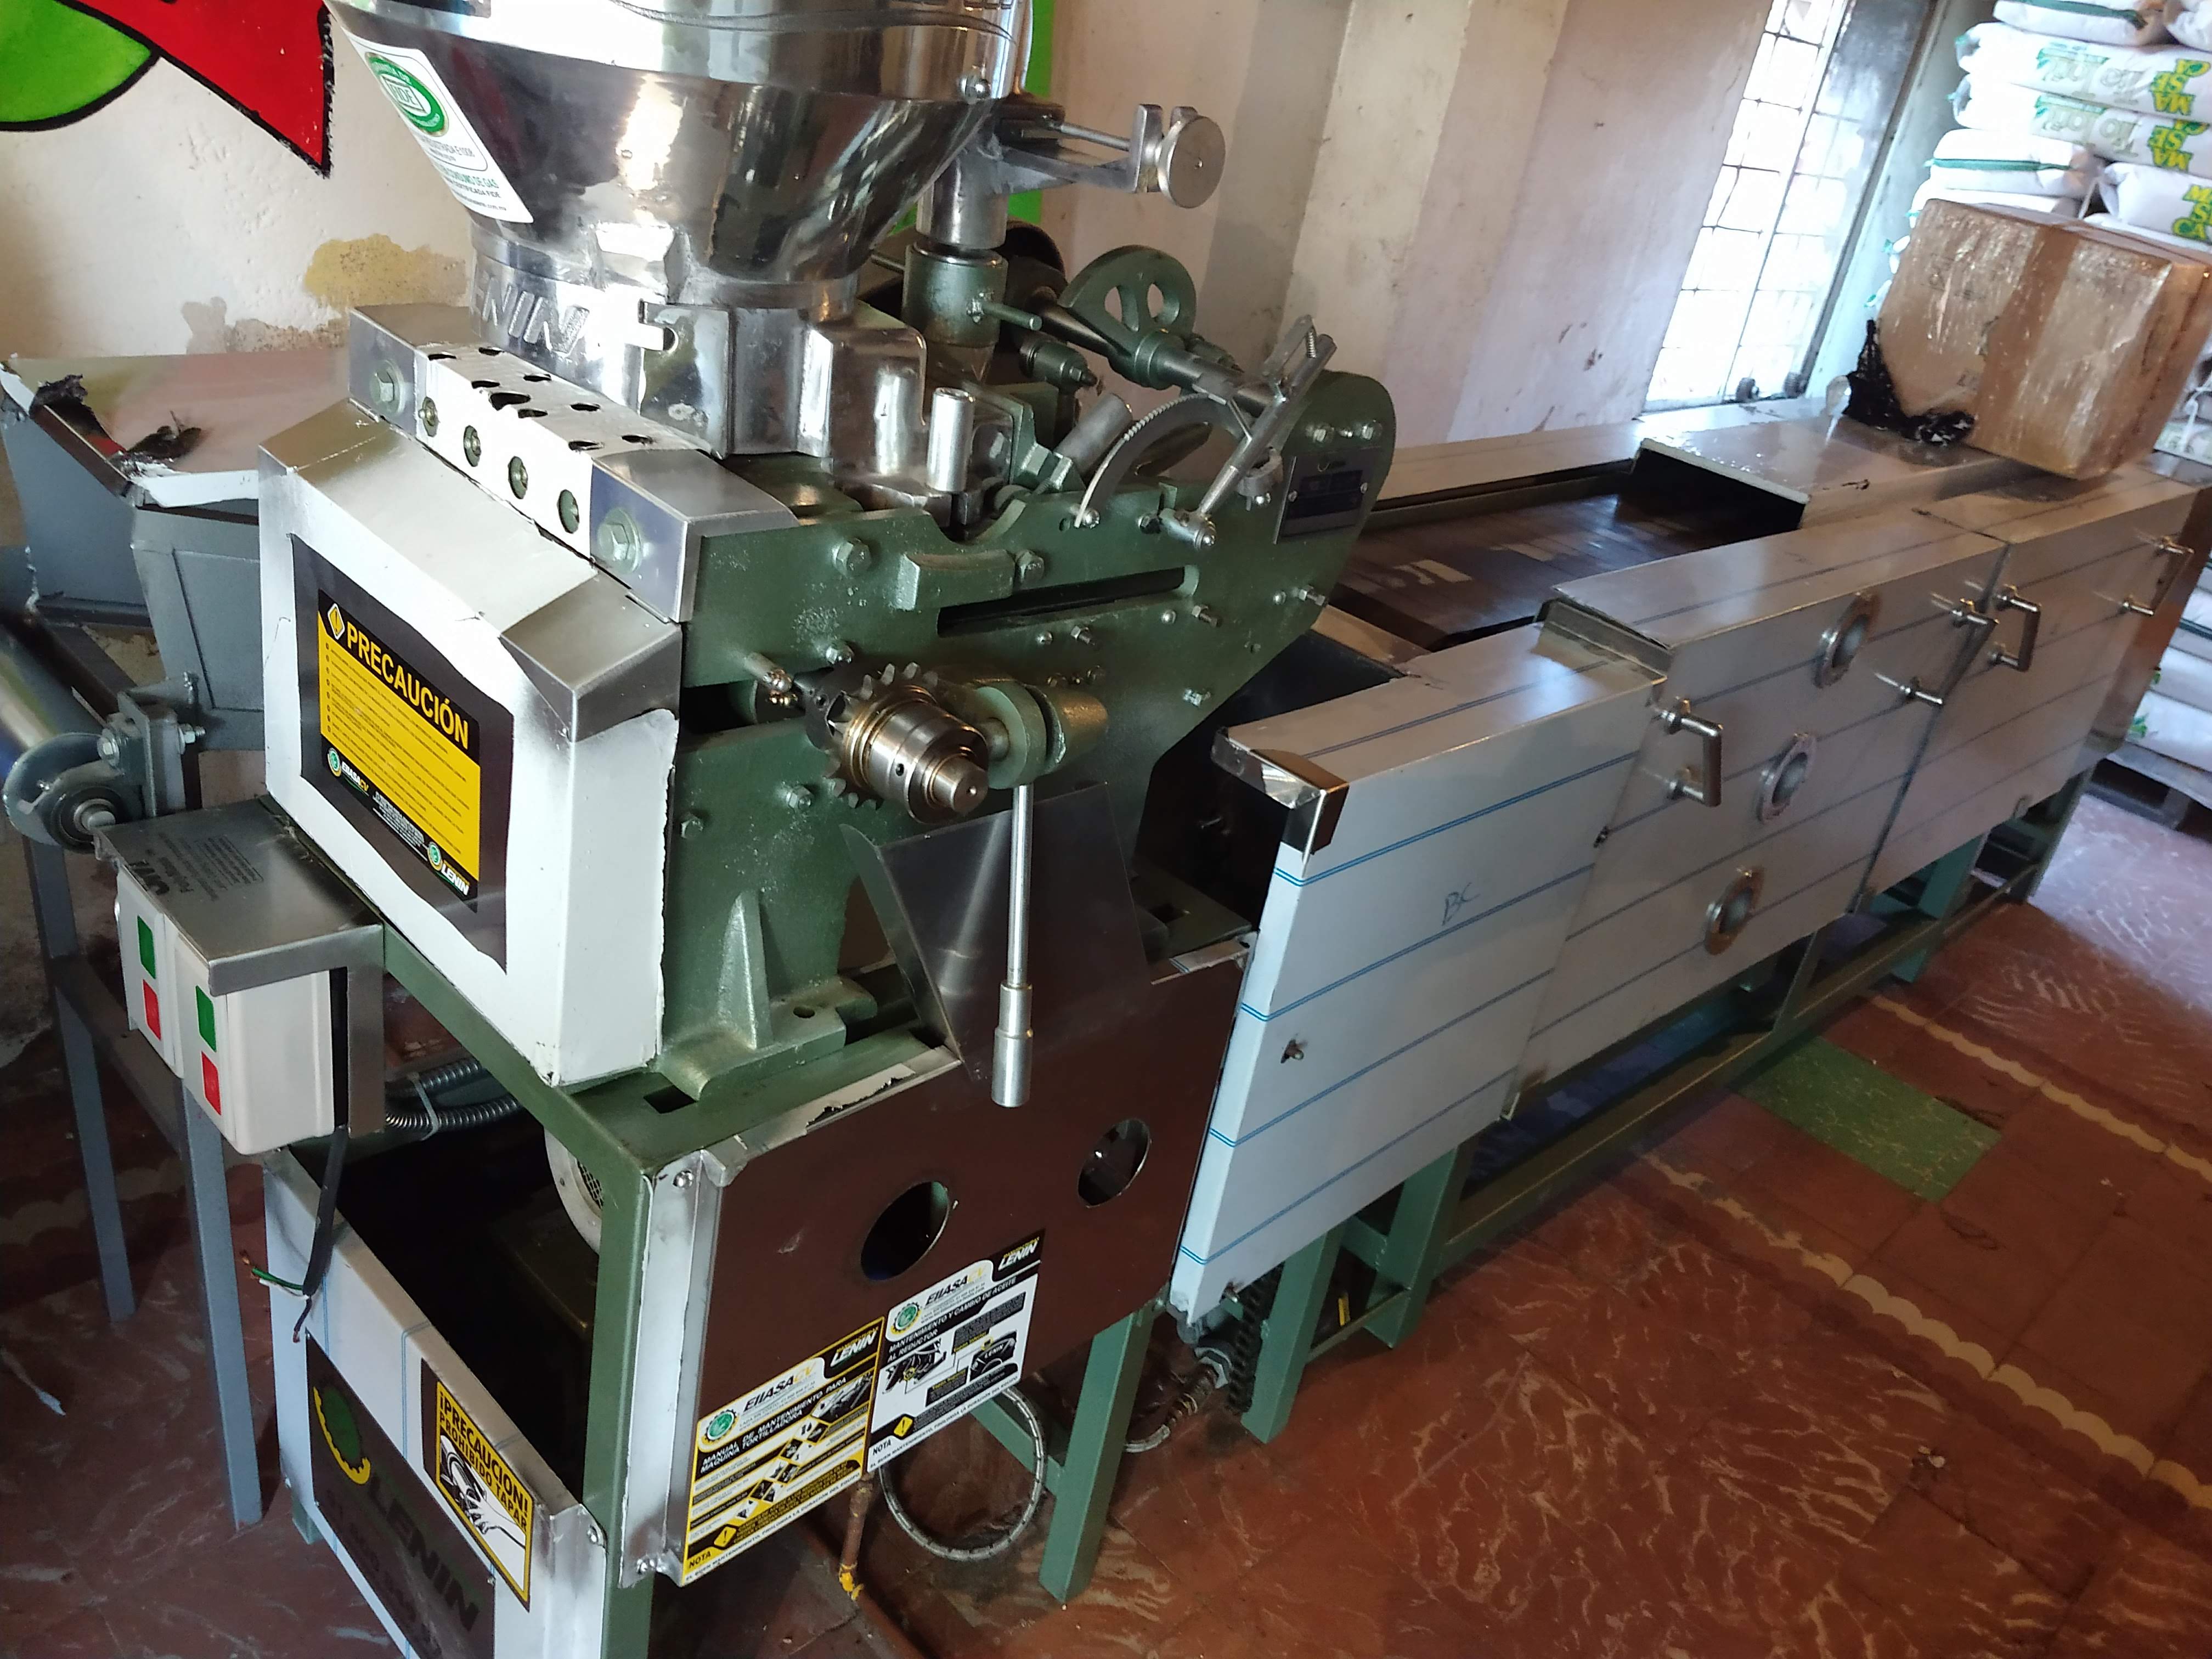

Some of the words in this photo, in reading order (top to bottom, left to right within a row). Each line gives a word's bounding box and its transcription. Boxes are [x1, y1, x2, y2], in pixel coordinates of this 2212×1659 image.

[2182, 184, 2212, 204] M
[2190, 202, 2212, 227] S
[347, 621, 469, 749] PRECAUCIÓN
[441, 863, 469, 895] LENIN
[997, 1239, 1038, 1272] LENIN
[888, 1314, 947, 1355] MANTENIMIENTO
[947, 1311, 953, 1320] Y
[953, 1295, 980, 1317] CAMBIO
[981, 1290, 991, 1301] DE
[992, 1276, 1016, 1295] ACEITE
[830, 1330, 877, 1368] LENIN
[887, 1351, 898, 1363] AL
[898, 1327, 938, 1357] REDUCTOR
[702, 1439, 738, 1466] MANUAL
[742, 1430, 754, 1443] DE
[758, 1390, 823, 1434] MANTENIMIENTO
[825, 1375, 847, 1394] PARA
[700, 1444, 740, 1474] MAQUINA
[742, 1408, 803, 1450] TORTILLADORA
[872, 1437, 891, 1456] NOTA
[439, 1410, 492, 1488] PROHIBIDO
[495, 1482, 527, 1533] TAPAR
[689, 1549, 712, 1569] NOTA
